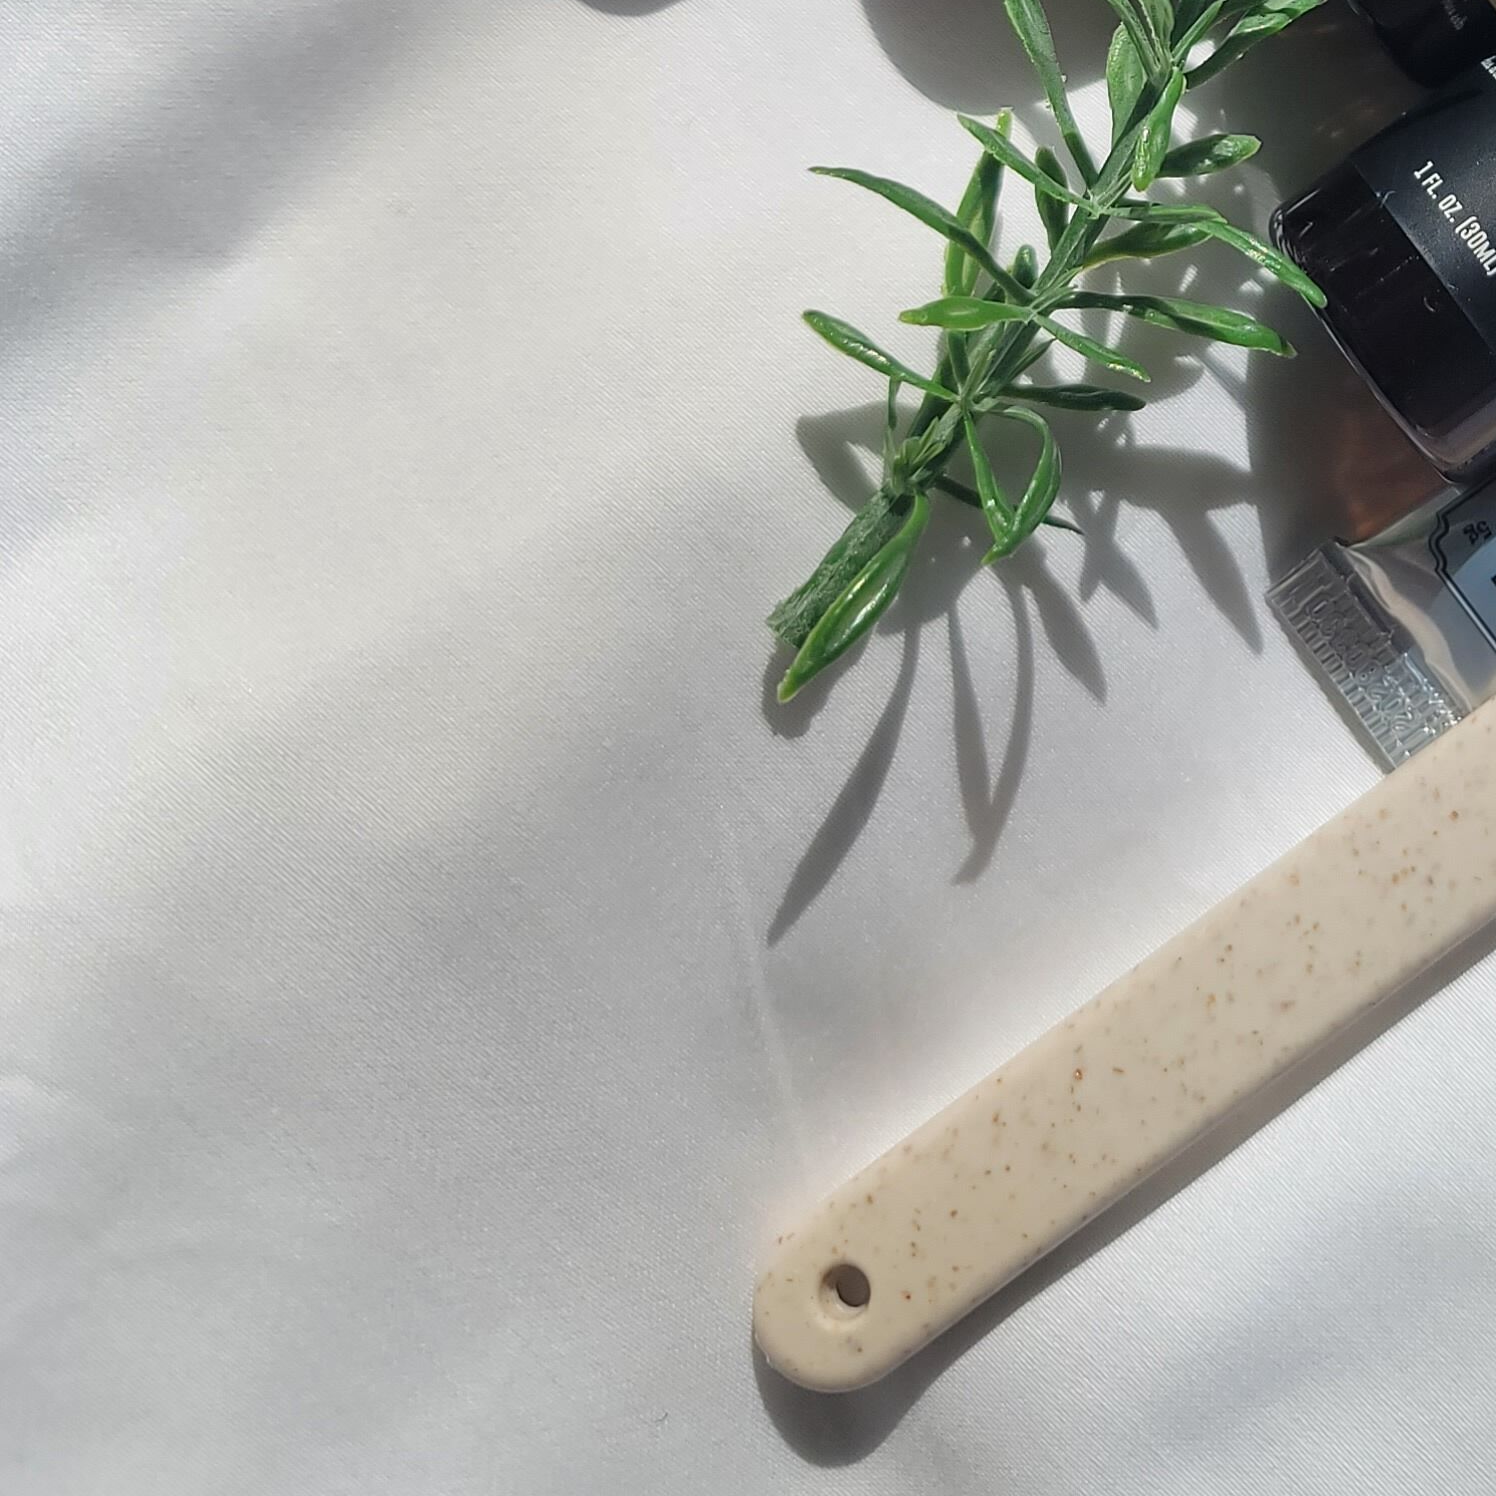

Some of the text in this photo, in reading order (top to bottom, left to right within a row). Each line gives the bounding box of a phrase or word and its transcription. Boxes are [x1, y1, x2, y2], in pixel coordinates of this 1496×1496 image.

[1413, 160, 1434, 179] 1
[1421, 172, 1443, 199] FL.
[1438, 193, 1463, 223] OZ.
[1463, 520, 1492, 545] 5g
